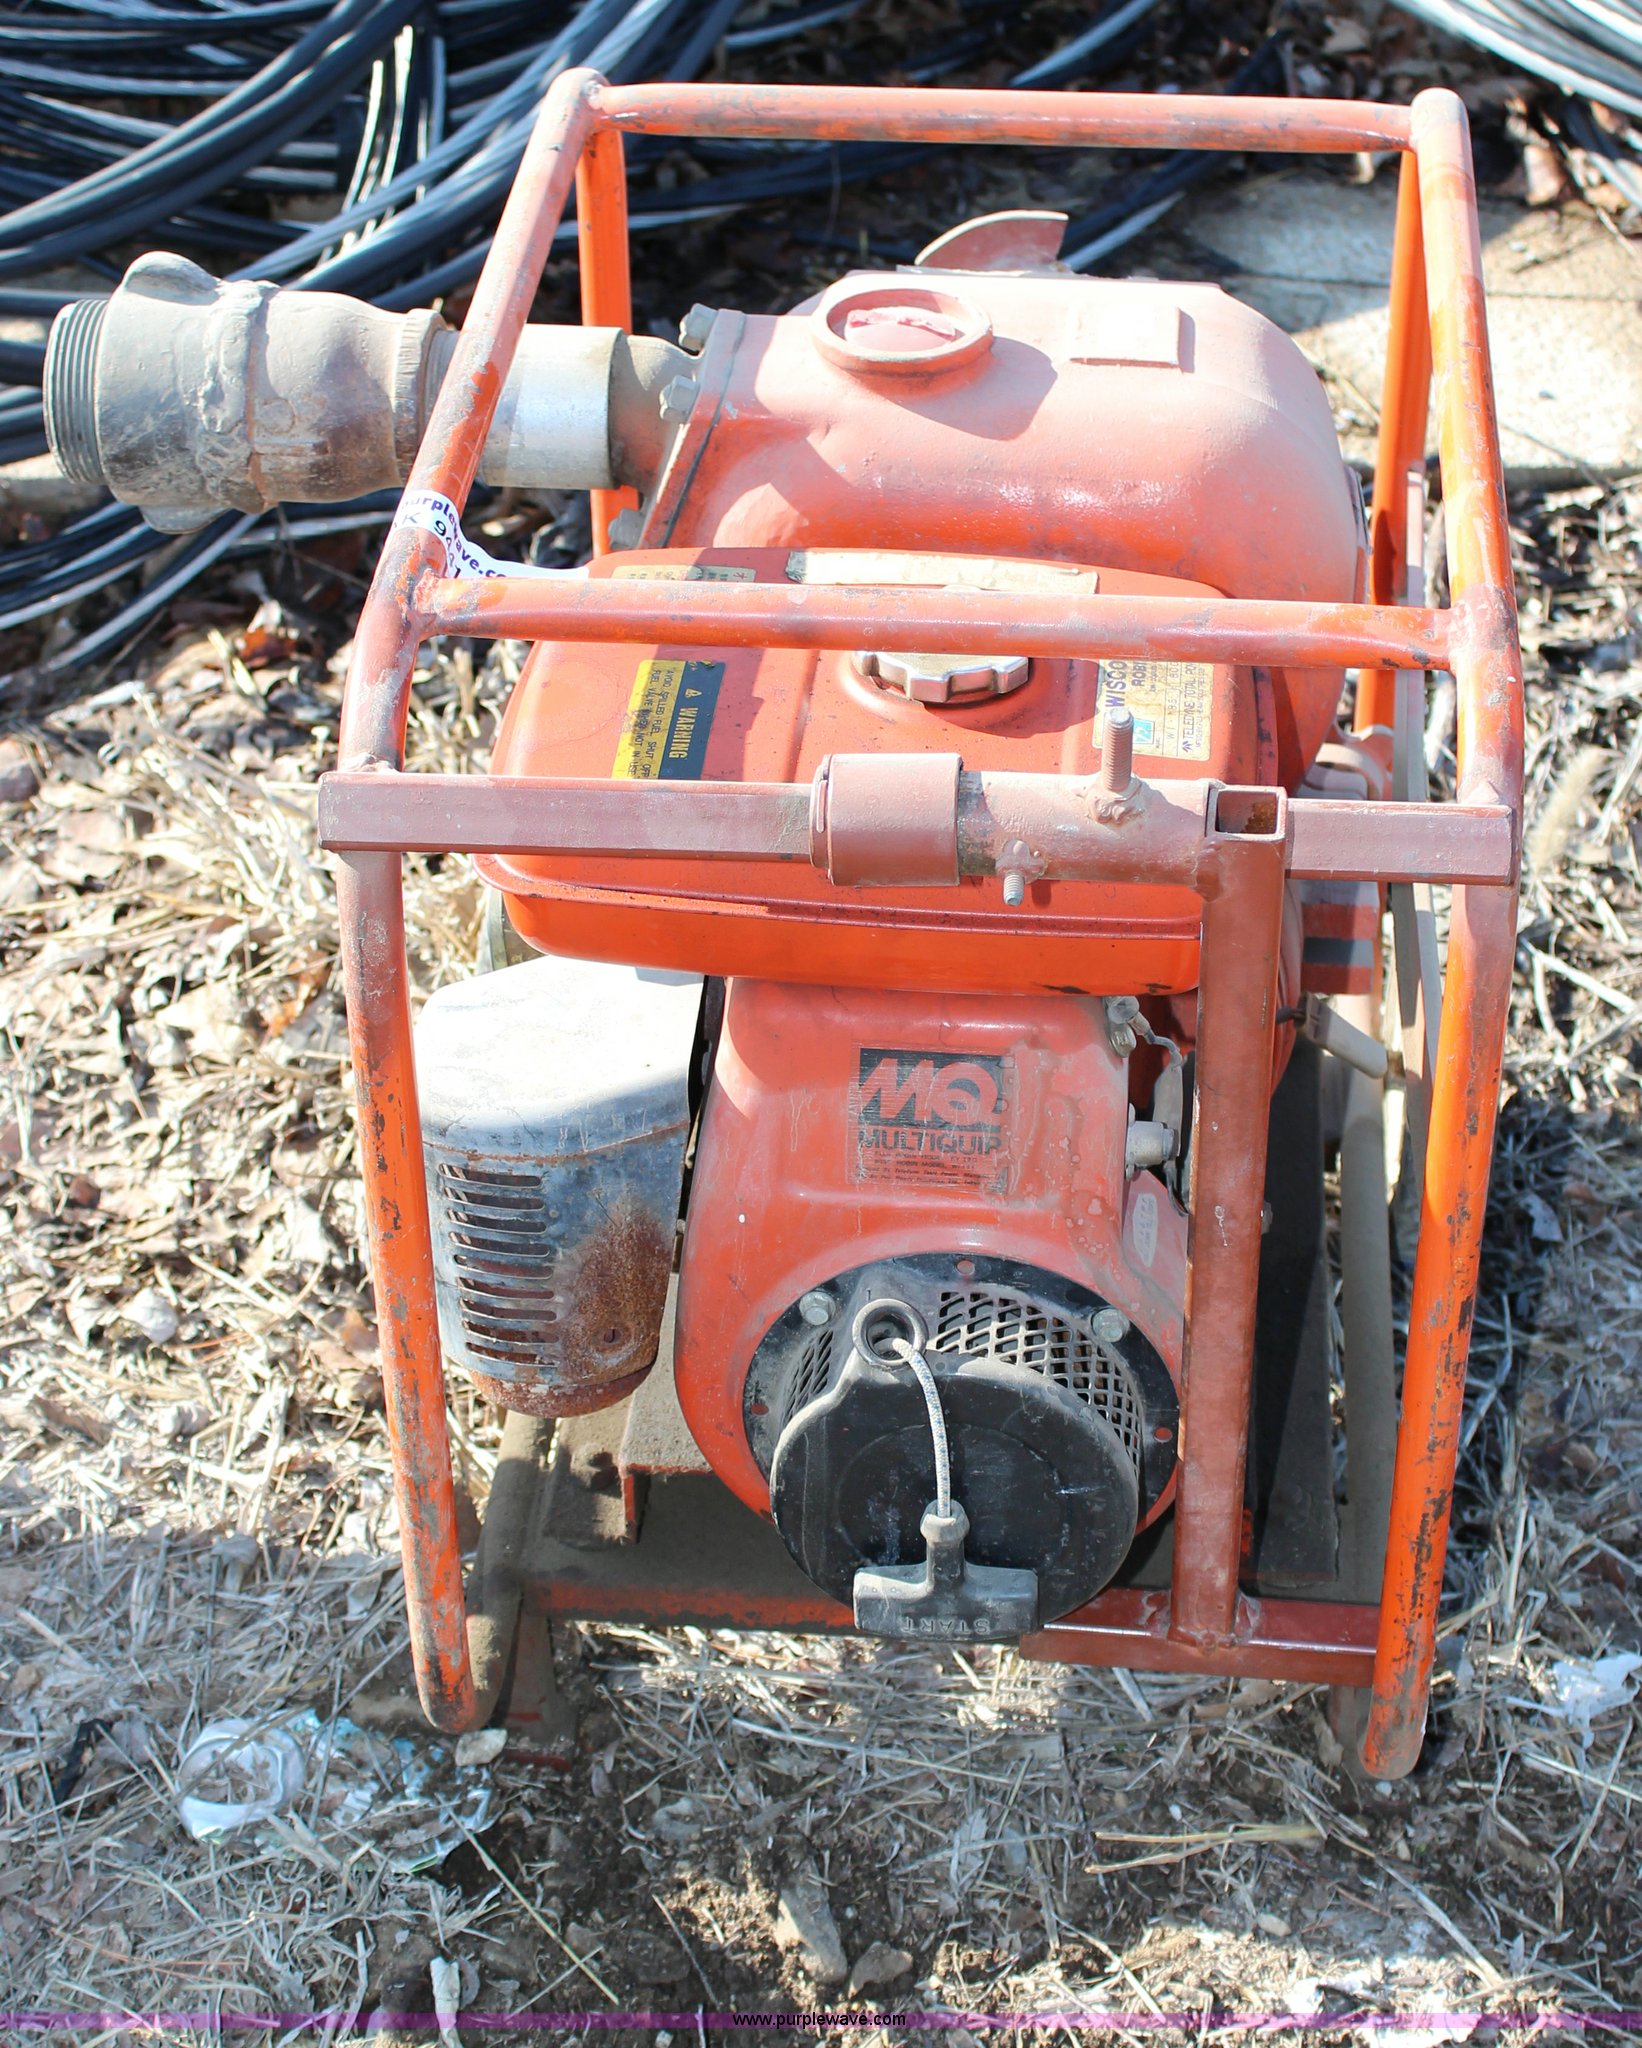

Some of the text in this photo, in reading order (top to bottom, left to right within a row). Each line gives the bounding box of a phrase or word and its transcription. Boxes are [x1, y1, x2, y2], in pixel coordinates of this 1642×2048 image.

[650, 670, 661, 684] FUEL
[662, 670, 674, 687] AVOID
[643, 687, 657, 706] VALVE
[1184, 678, 1196, 699] TOTAL
[655, 691, 670, 715] SPILLED
[1183, 701, 1196, 739] TELEDYNE
[634, 732, 645, 747] NOT
[668, 707, 699, 759] WARNING
[631, 750, 641, 758] IN
[645, 741, 657, 759] SHUT
[859, 1056, 1001, 1127] MQ
[858, 1128, 1003, 1155] MULTIQUIP
[901, 1616, 991, 1635] START
